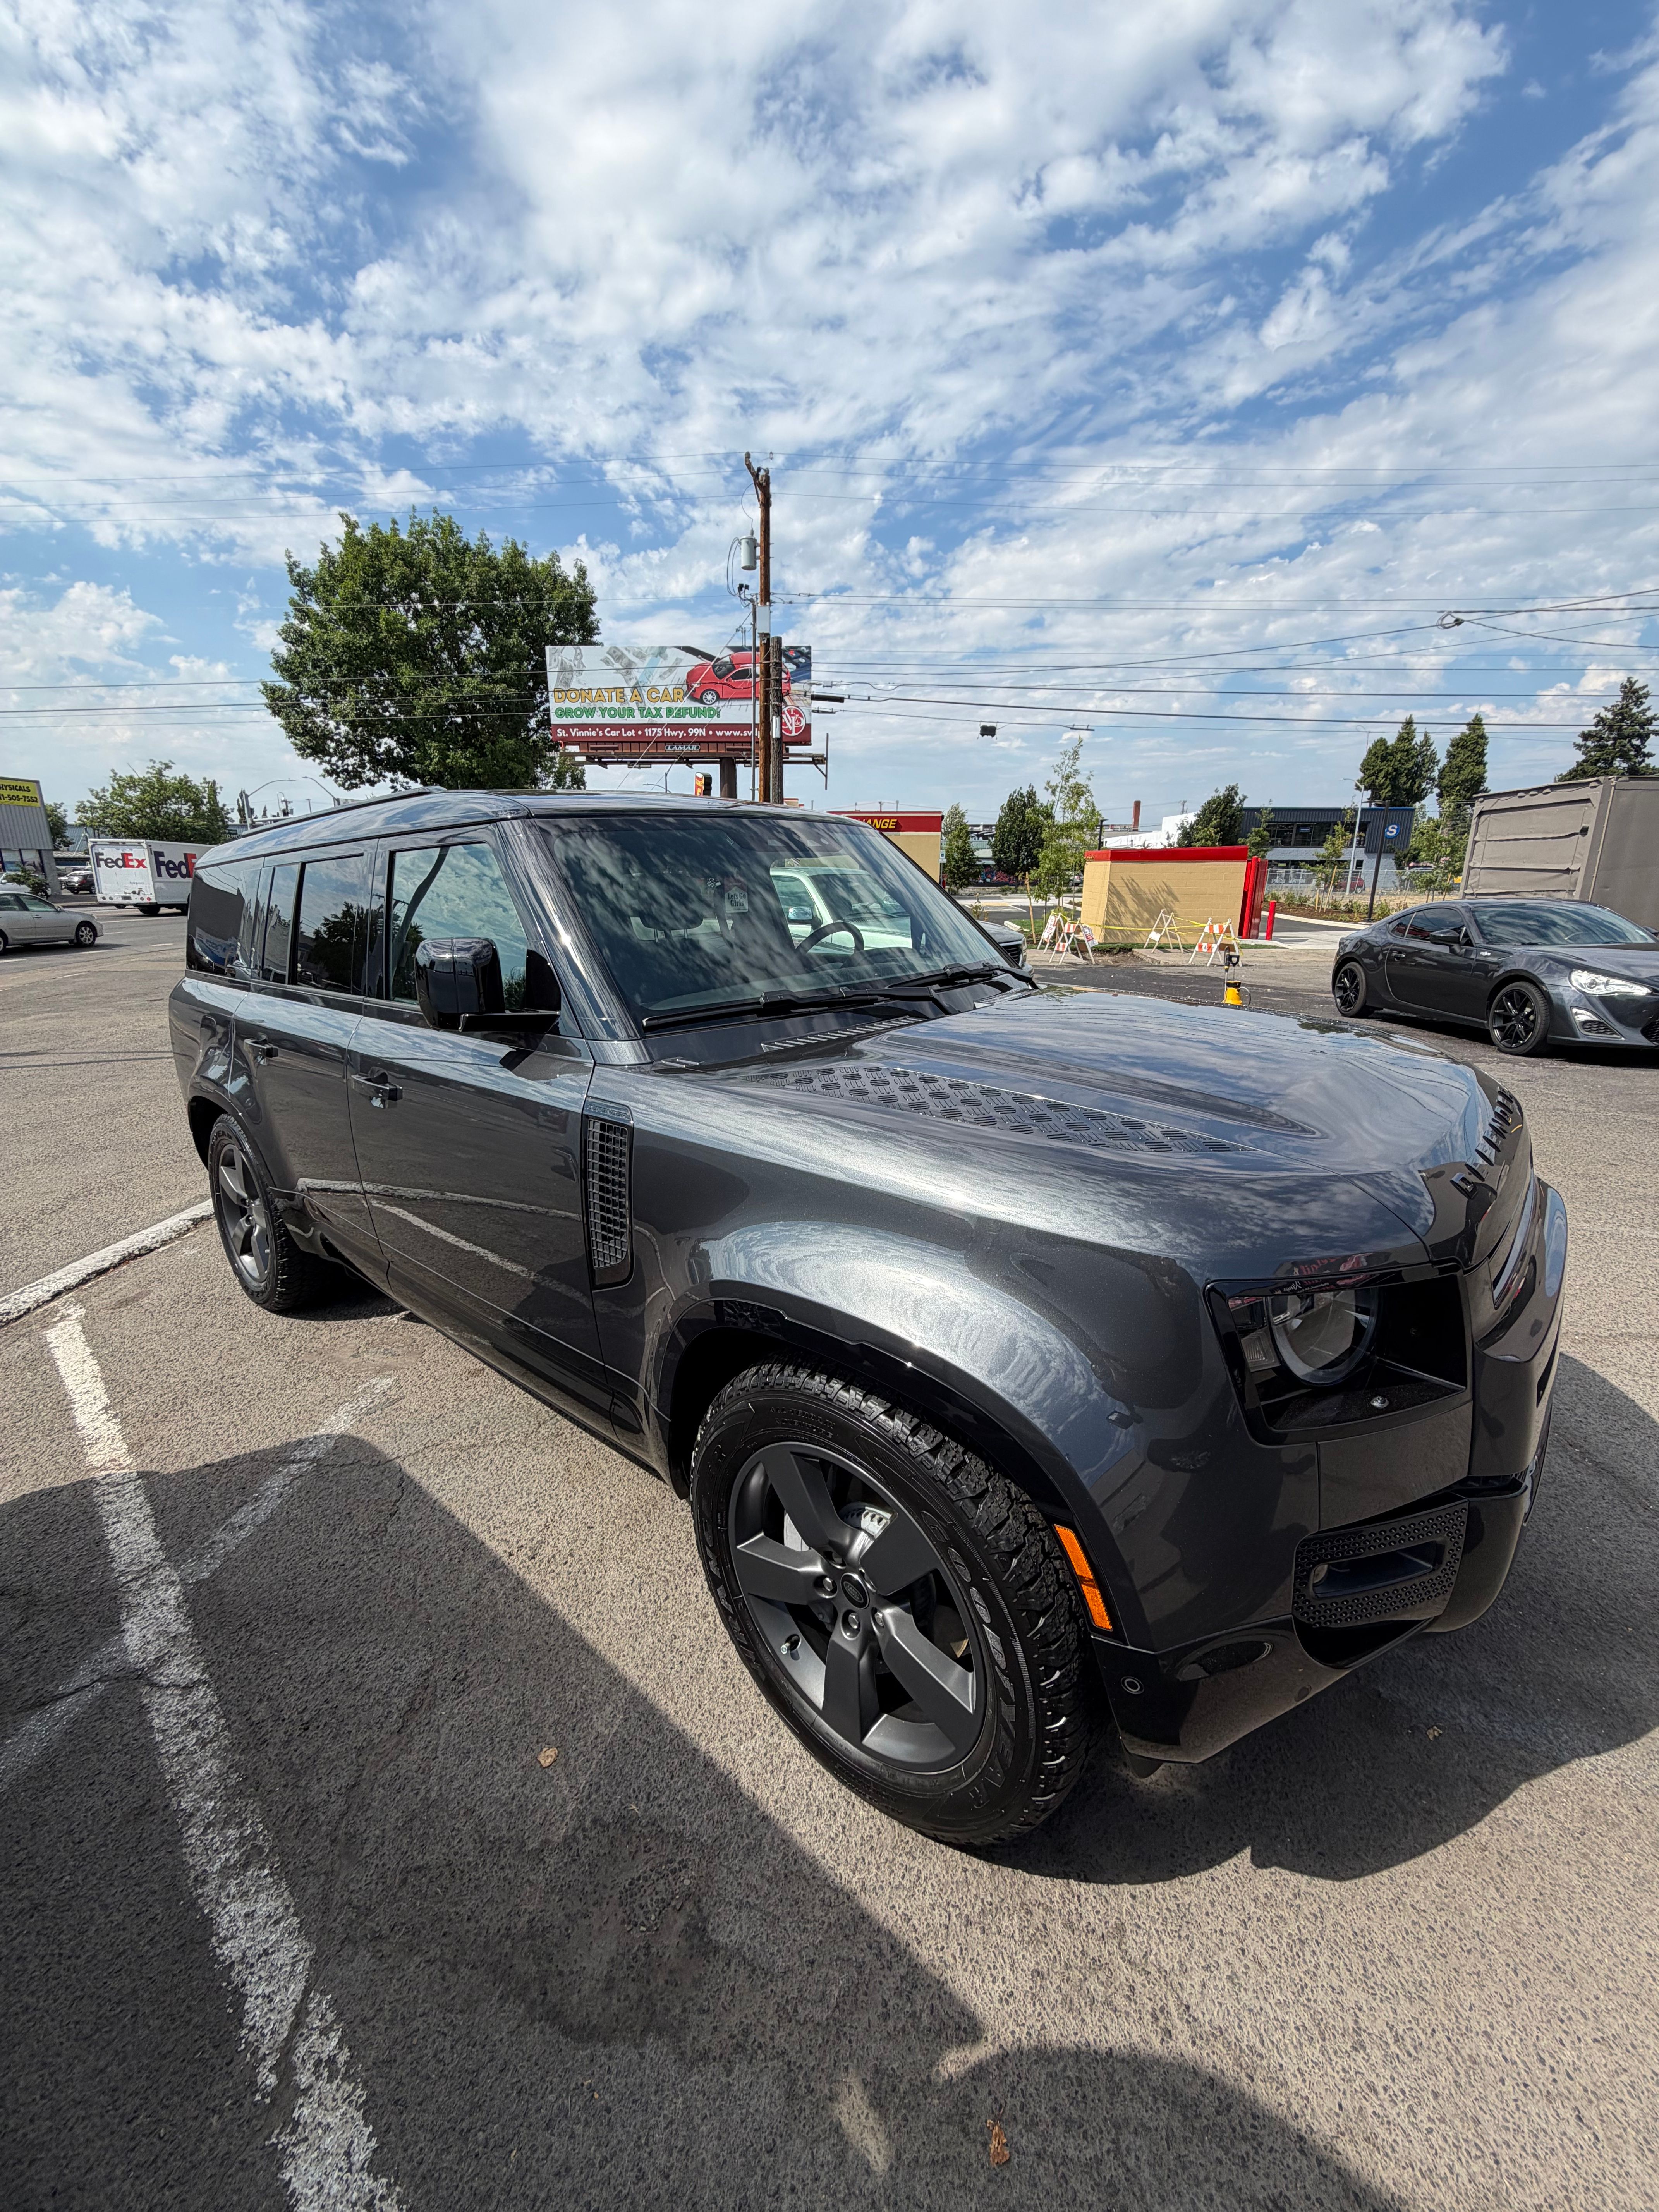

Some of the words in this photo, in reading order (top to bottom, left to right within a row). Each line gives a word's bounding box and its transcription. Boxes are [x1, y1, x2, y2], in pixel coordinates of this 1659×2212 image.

[553, 687, 625, 703] DONATE
[630, 687, 643, 703] A
[647, 687, 685, 703] CAR
[555, 707, 596, 718] GROW
[599, 707, 635, 718] YOUR
[638, 707, 663, 718] TAX
[666, 706, 721, 718] REFUND!
[557, 728, 568, 737] St.
[570, 728, 603, 737] Vinnie's
[605, 728, 620, 737] Car
[622, 728, 635, 737] Lot
[644, 728, 662, 737] 1175
[664, 728, 686, 738] Hwy.
[688, 728, 706, 737] 99N
[1386, 825, 1398, 836] S
[95, 852, 148, 868] FedEx
[153, 850, 197, 879] FedE
[587, 1104, 627, 1119] DEFENDER
[920, 1510, 1016, 1809] GOODYEAR
